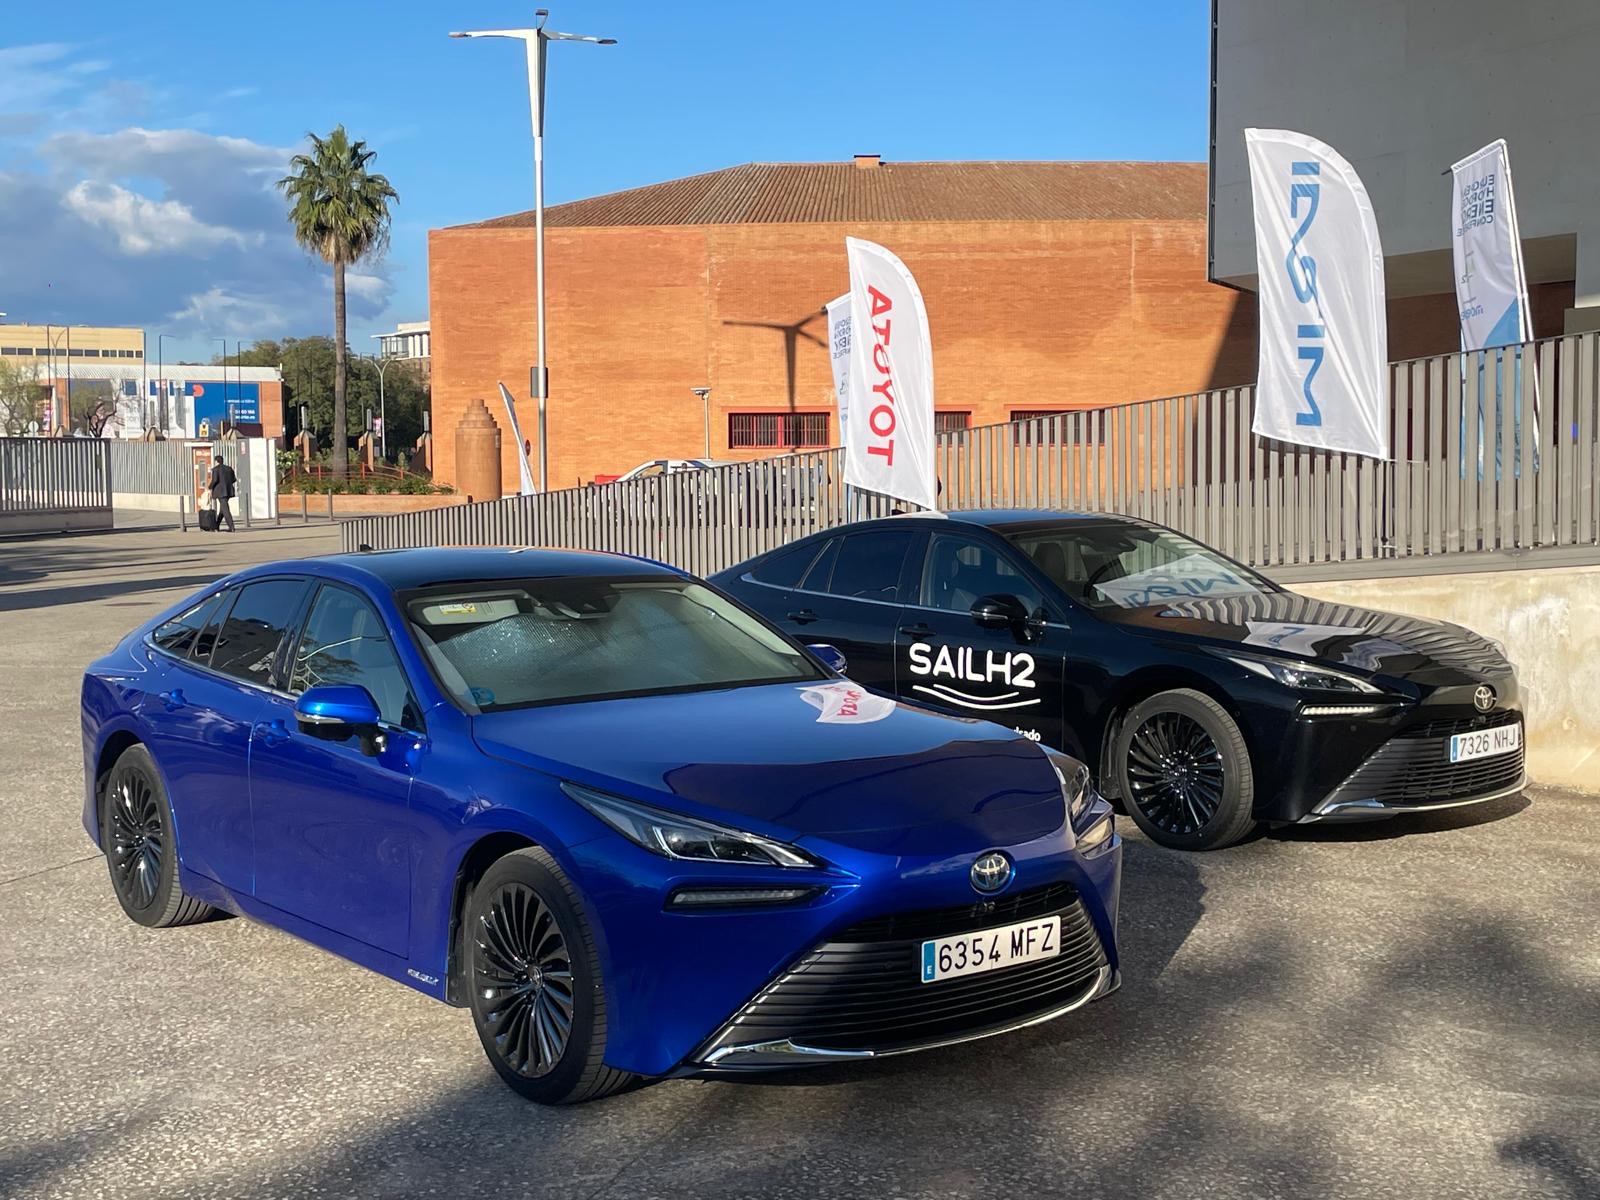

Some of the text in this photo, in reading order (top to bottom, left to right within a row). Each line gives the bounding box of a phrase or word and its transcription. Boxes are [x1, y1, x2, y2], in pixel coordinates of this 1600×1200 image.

[909, 642, 1036, 689] SAILH2
[1460, 728, 1516, 758] 7326 NHJ
[938, 935, 1001, 973] 6354
[1010, 923, 1054, 959] MFZ
